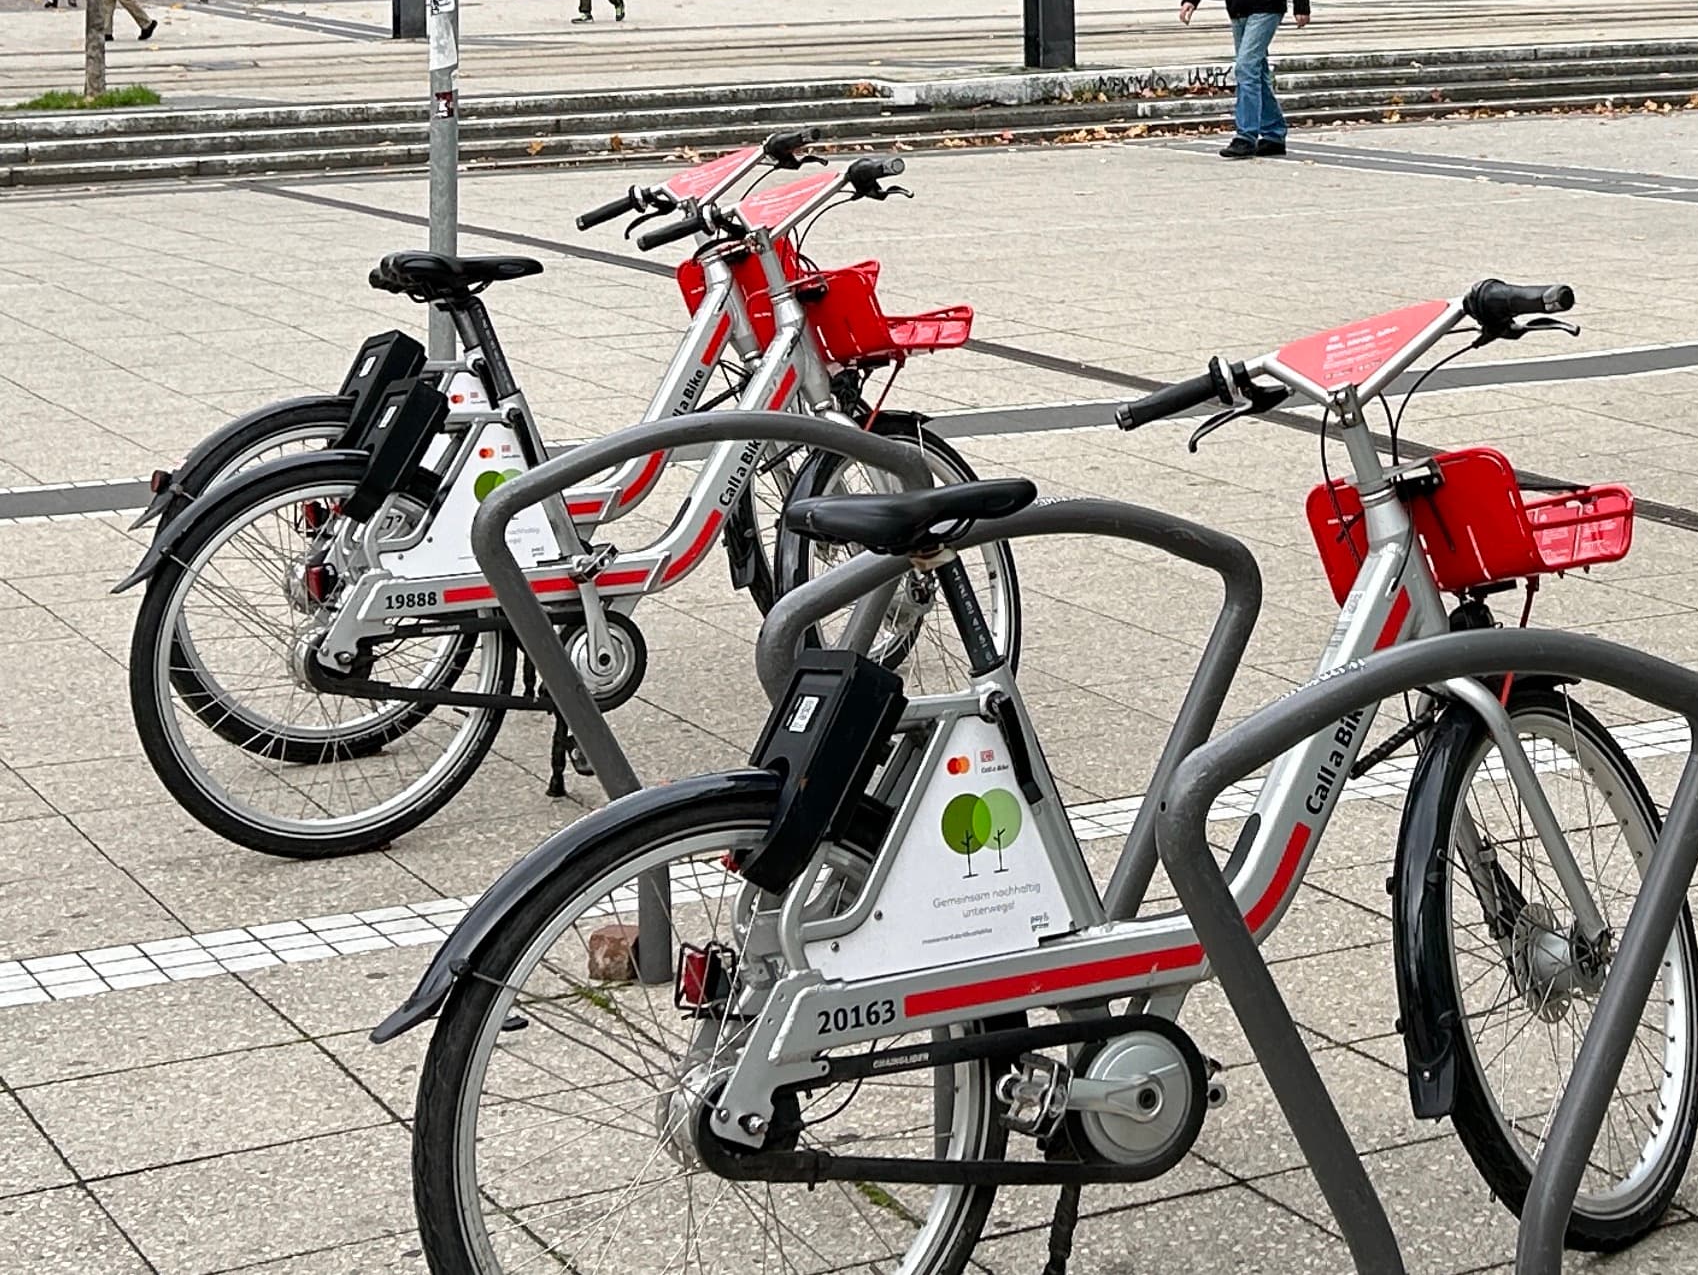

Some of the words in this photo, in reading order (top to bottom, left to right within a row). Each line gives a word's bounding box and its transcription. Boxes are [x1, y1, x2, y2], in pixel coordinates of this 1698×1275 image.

[719, 476, 742, 507] Call
[740, 439, 761, 467] Bik
[385, 592, 438, 611] 19888
[1333, 710, 1364, 749] Bik
[1329, 749, 1346, 769] a
[1305, 765, 1338, 815] Call
[932, 892, 991, 909] Gemeinsam
[992, 882, 1042, 899] nachhaltig
[817, 999, 896, 1035] 20163
